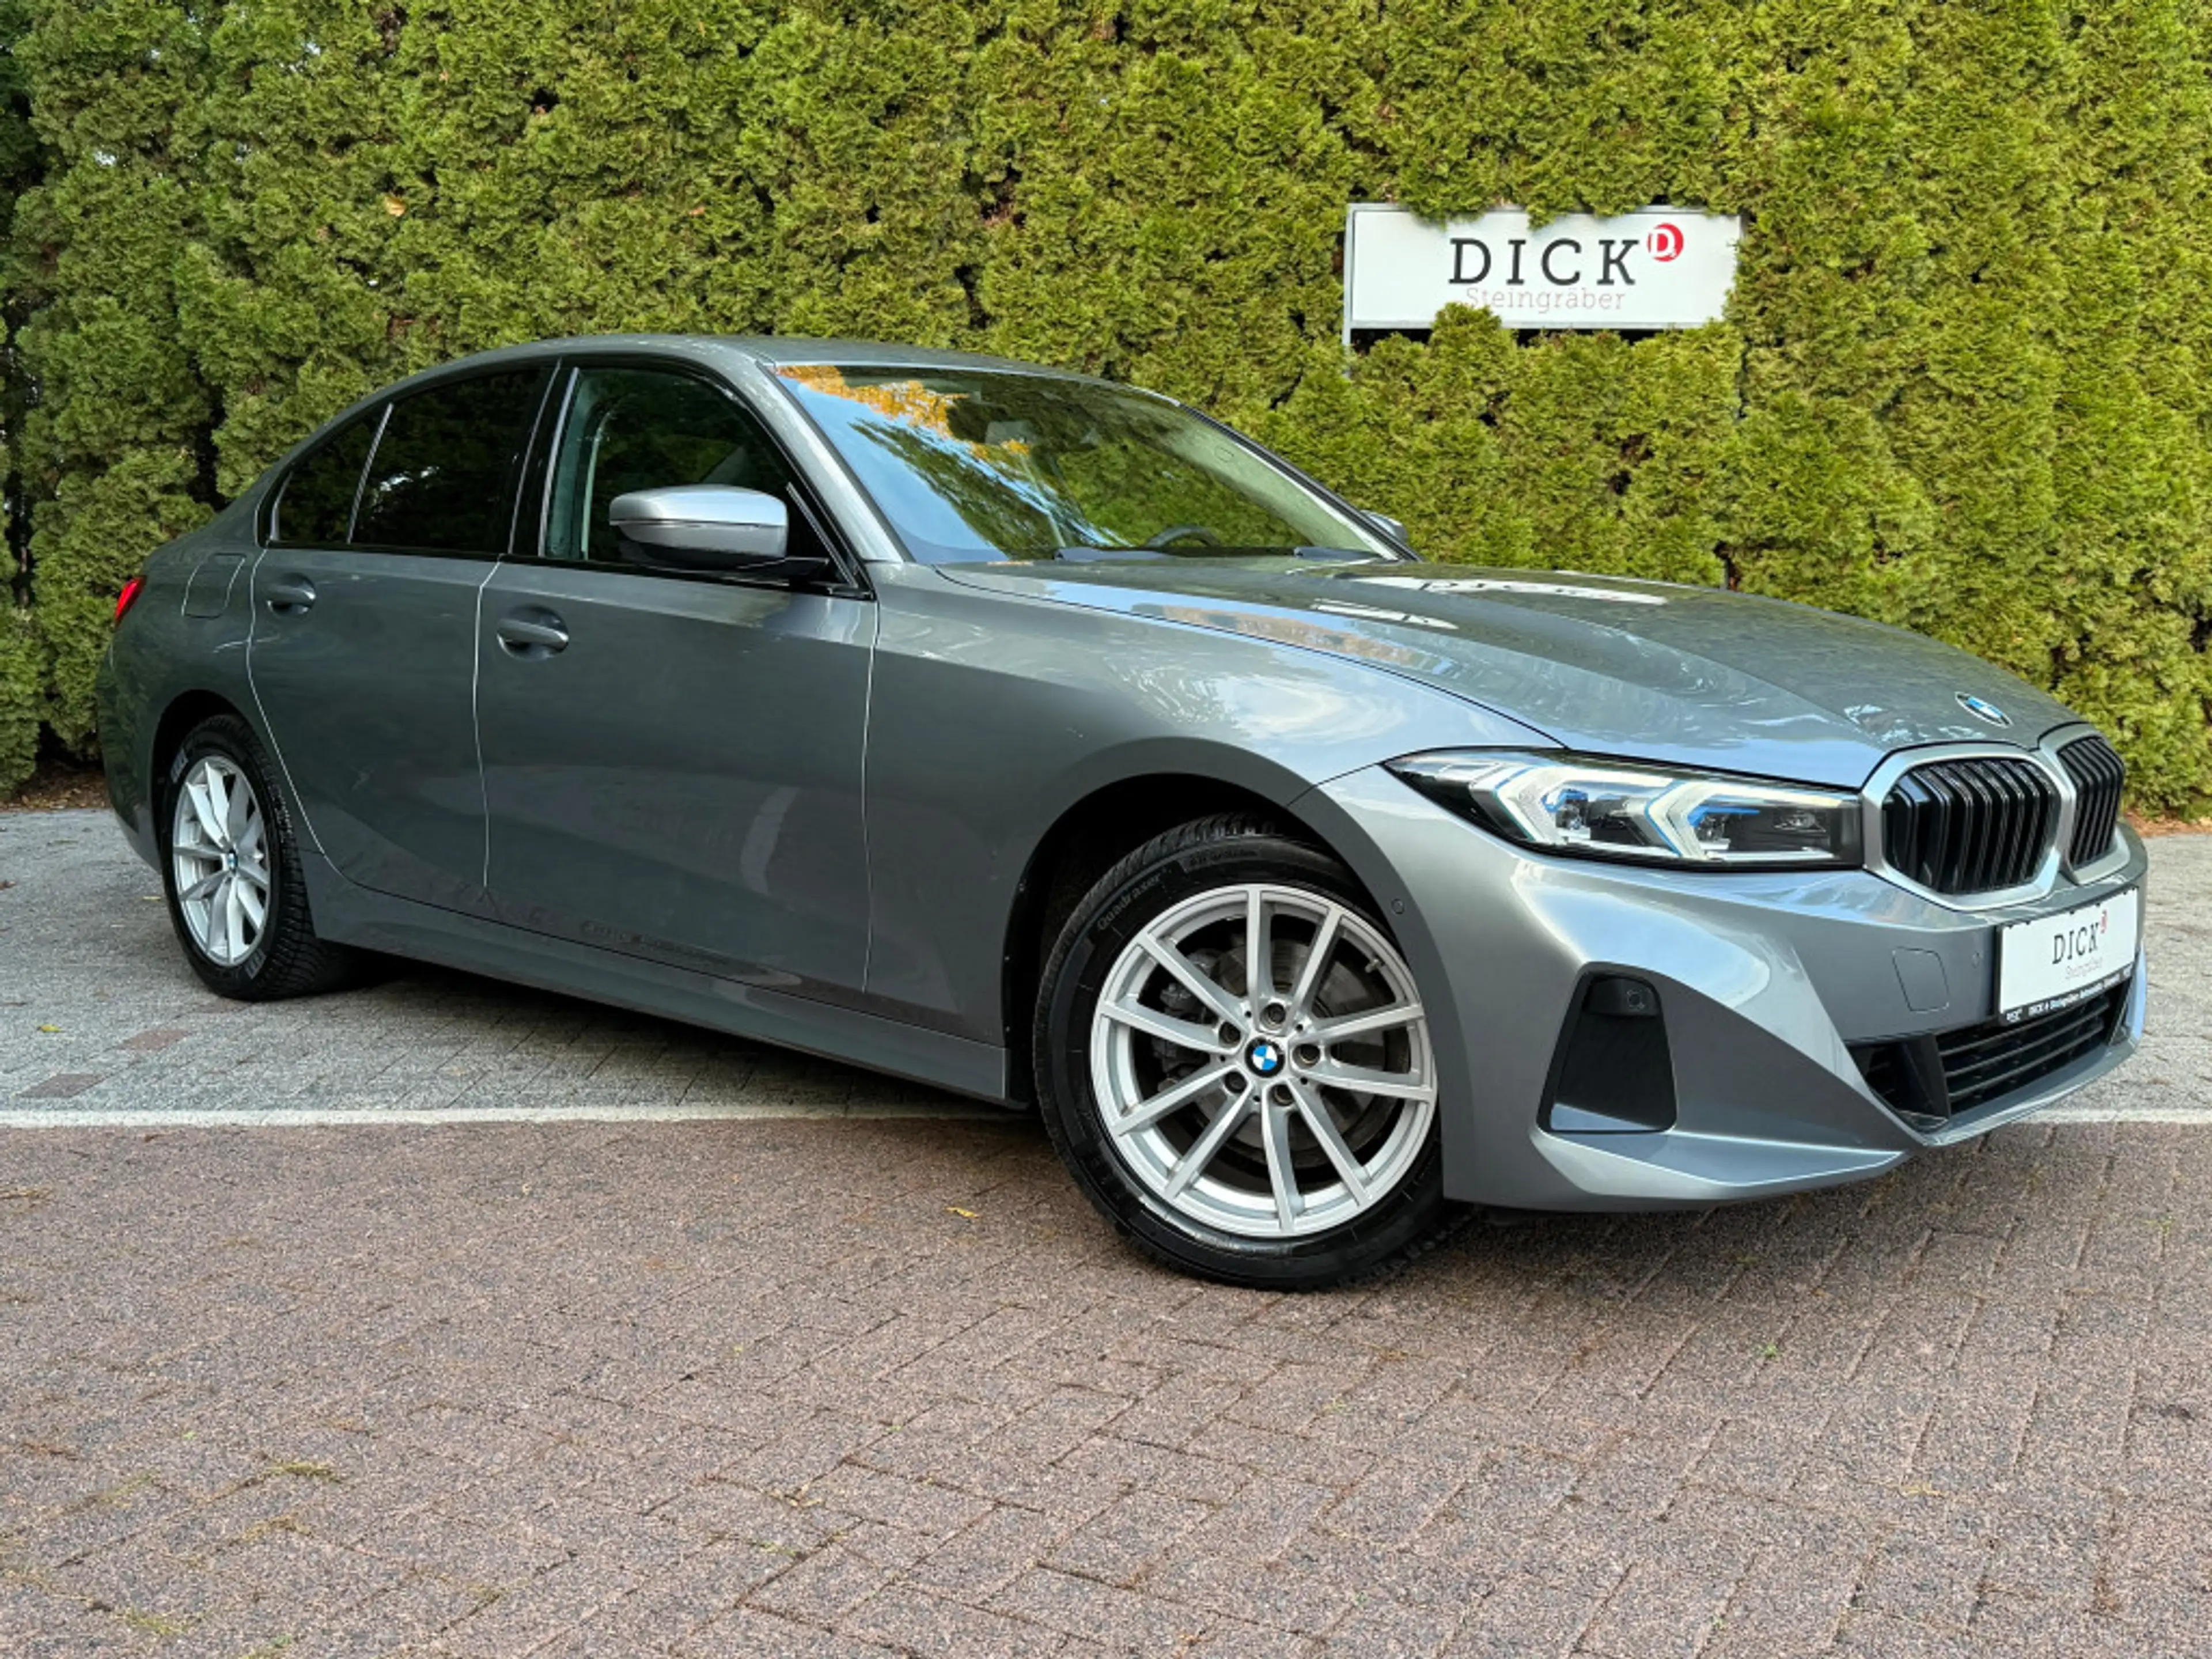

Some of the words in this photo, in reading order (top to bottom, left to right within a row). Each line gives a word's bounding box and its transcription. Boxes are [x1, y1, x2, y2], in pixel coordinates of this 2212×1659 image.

[1448, 237, 1640, 286] DICK
[1465, 287, 1626, 314] Steingräber
[2052, 922, 2099, 964] DICK
